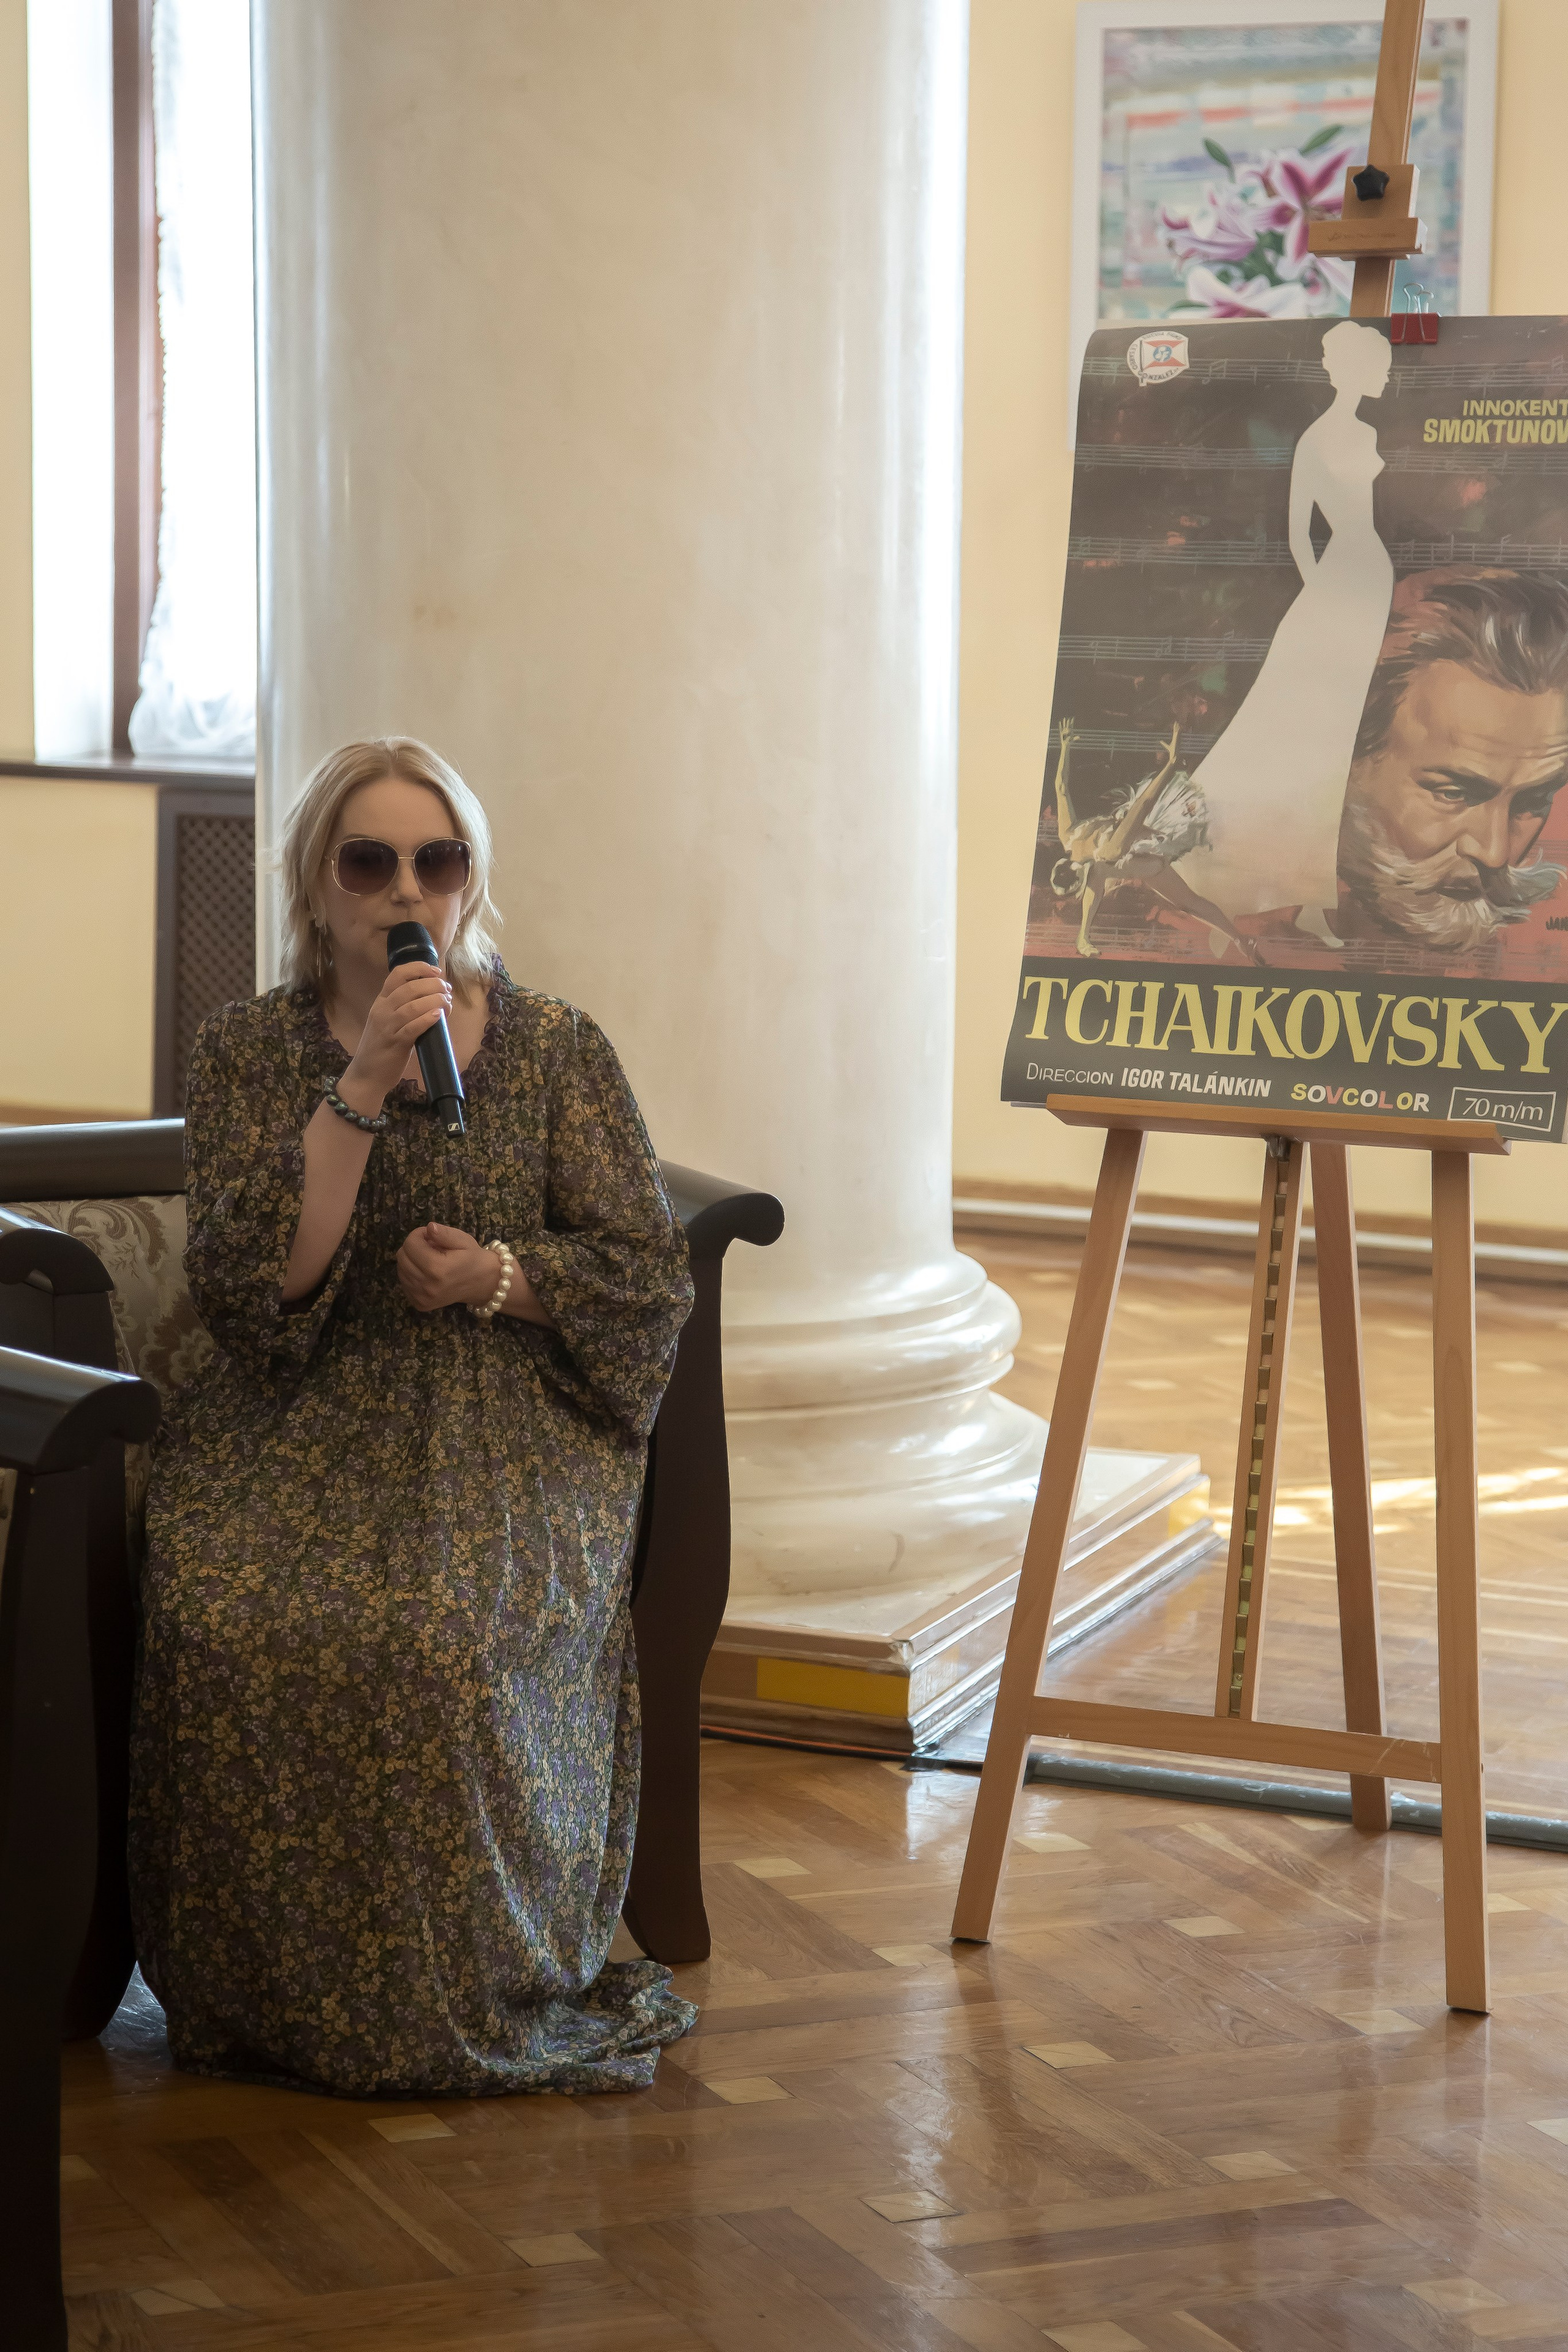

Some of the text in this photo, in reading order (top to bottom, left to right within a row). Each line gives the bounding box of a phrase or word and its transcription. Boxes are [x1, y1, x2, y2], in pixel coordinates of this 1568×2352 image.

[1022, 976, 1568, 1073] TCHAIKOVSKY
[1121, 1068, 1164, 1089] IGOR
[1169, 1071, 1272, 1097] TALÁNKIN
